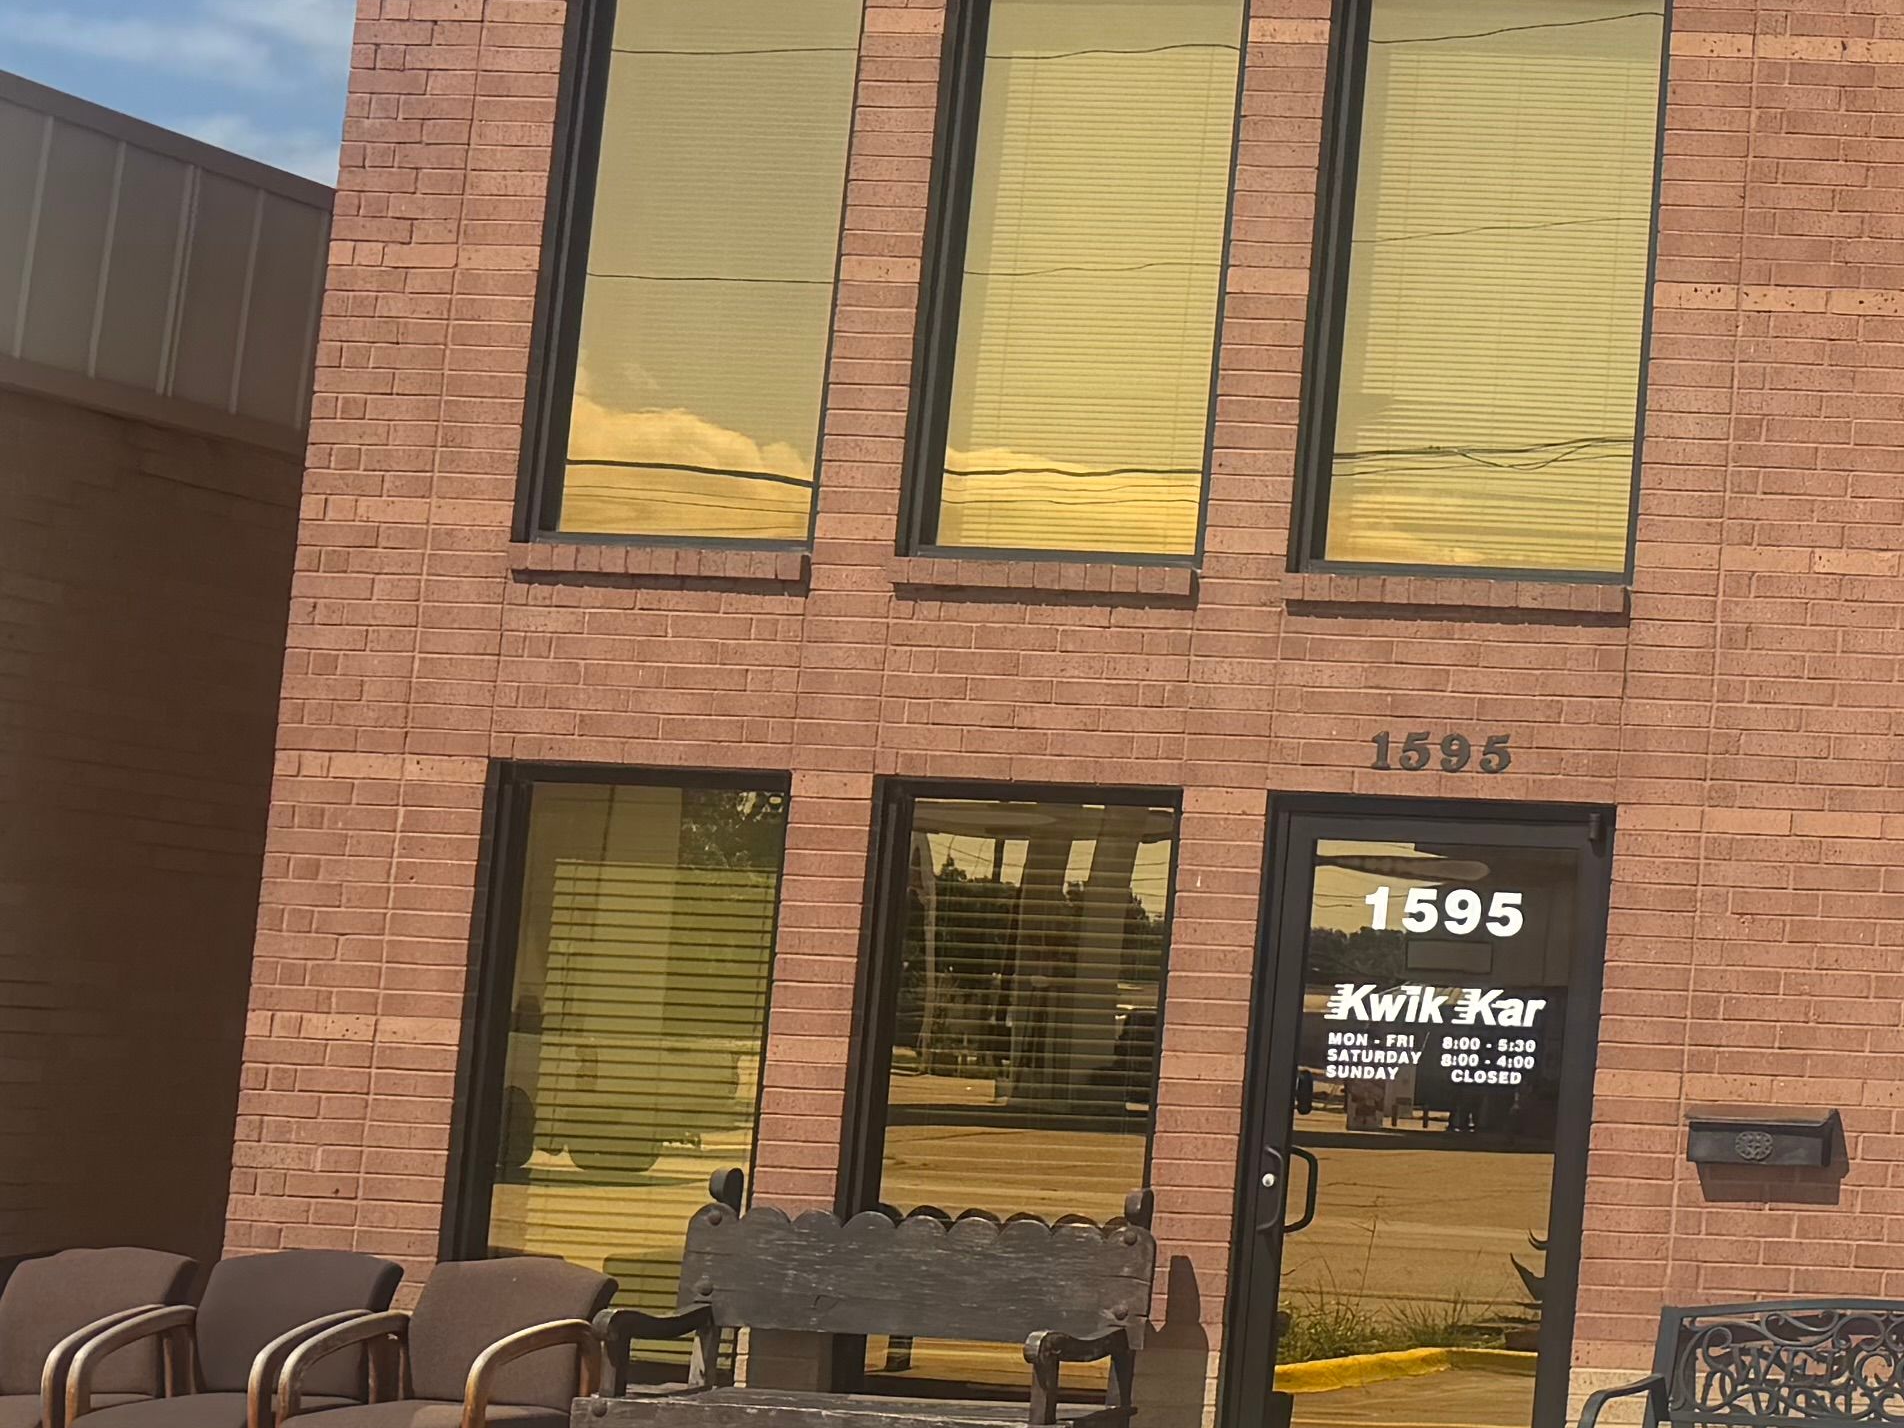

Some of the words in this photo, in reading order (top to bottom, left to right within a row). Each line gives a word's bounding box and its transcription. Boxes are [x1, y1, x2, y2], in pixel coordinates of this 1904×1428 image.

[1370, 730, 1512, 773] 1595
[1365, 886, 1524, 937] 1595
[1324, 983, 1450, 1023] Kwik
[1451, 988, 1547, 1027] Kar
[1328, 1032, 1368, 1046] MON
[1386, 1034, 1414, 1048] FRI
[1442, 1036, 1480, 1050] 8:00
[1497, 1039, 1536, 1052] 5:30
[1326, 1065, 1399, 1080] SUNDAY
[1451, 1069, 1522, 1084] CLOSED
[1327, 1049, 1422, 1065] SATURDAY
[1440, 1053, 1479, 1067] 8:00
[1496, 1055, 1535, 1070] 4:00
